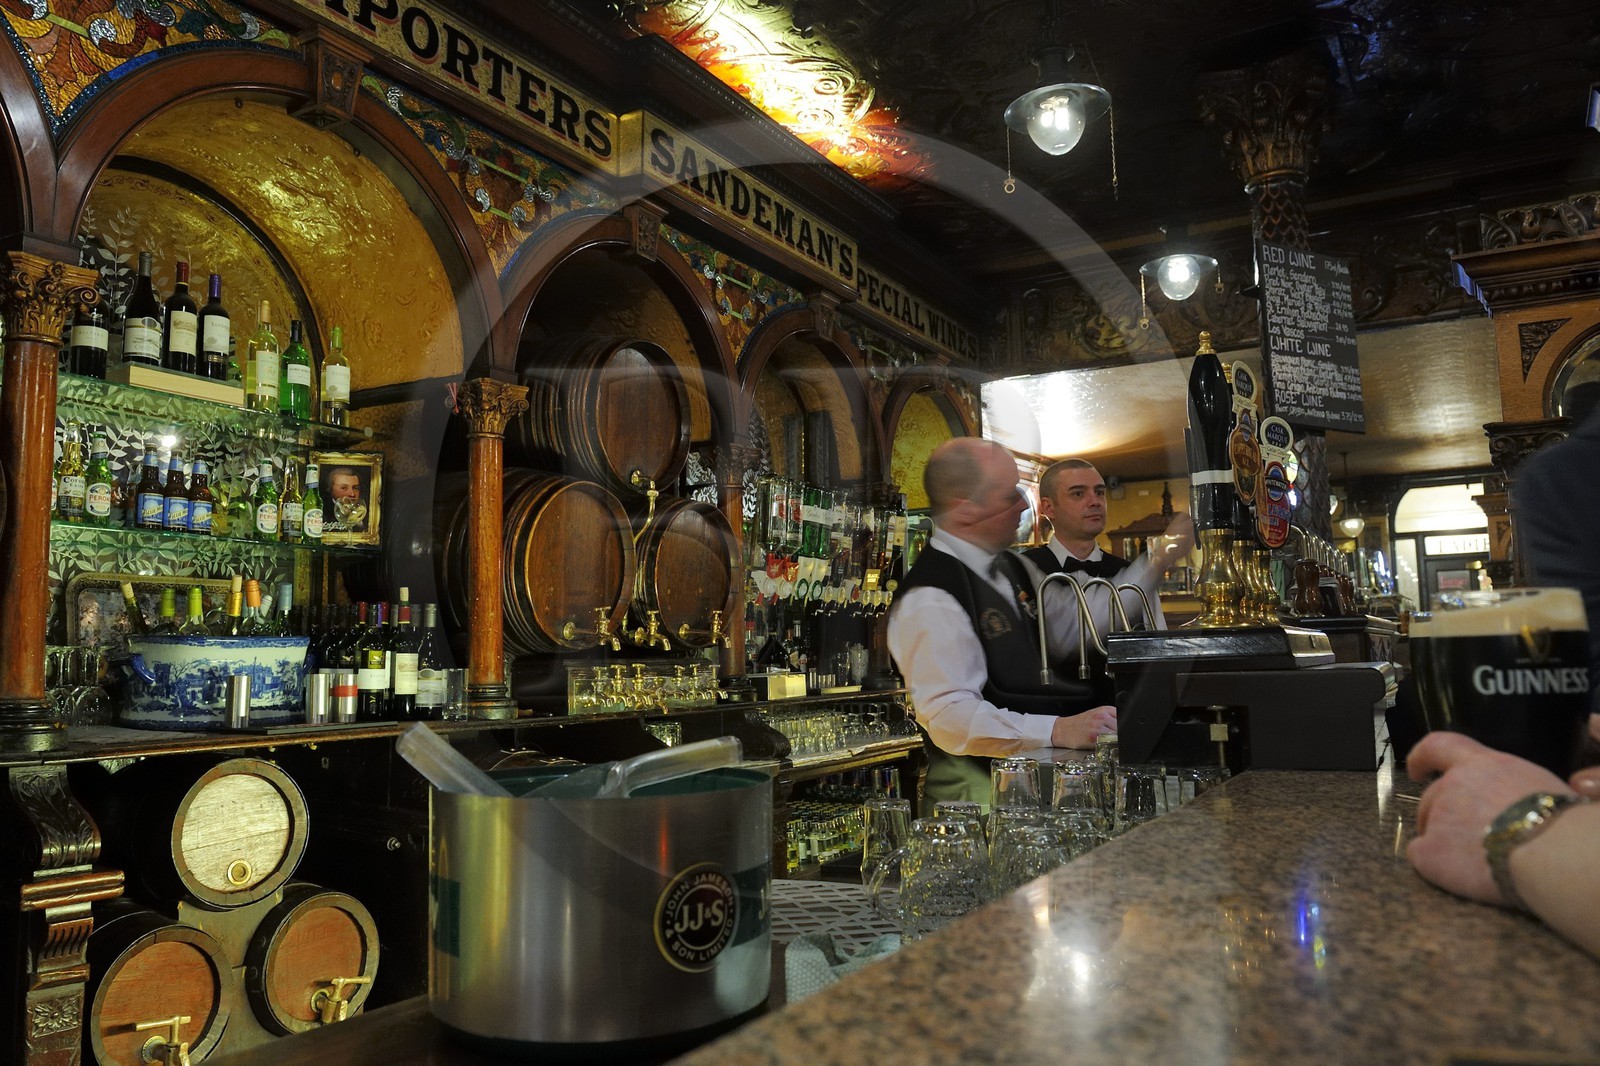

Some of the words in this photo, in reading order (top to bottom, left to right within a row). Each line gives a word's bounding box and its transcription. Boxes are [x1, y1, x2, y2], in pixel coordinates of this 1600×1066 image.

[650, 127, 855, 282] SANDEMAN'S
[1262, 244, 1285, 264] RED
[1289, 250, 1316, 270] WINE
[857, 267, 925, 333] PECIAL
[926, 309, 977, 360] WINES
[1268, 321, 1281, 335] Los
[1270, 335, 1303, 354] WHITE
[1307, 341, 1332, 357] WINE
[1301, 393, 1325, 408] WINE
[1267, 432, 1288, 443] MARQUE
[1271, 425, 1284, 434] CASK
[89, 494, 110, 502] PERON
[1472, 664, 1590, 696] GUINNESS
[665, 880, 690, 918] JOHN
[674, 898, 724, 933] JJ&S
[671, 940, 695, 961] SON
[699, 919, 733, 961] LIMITED
